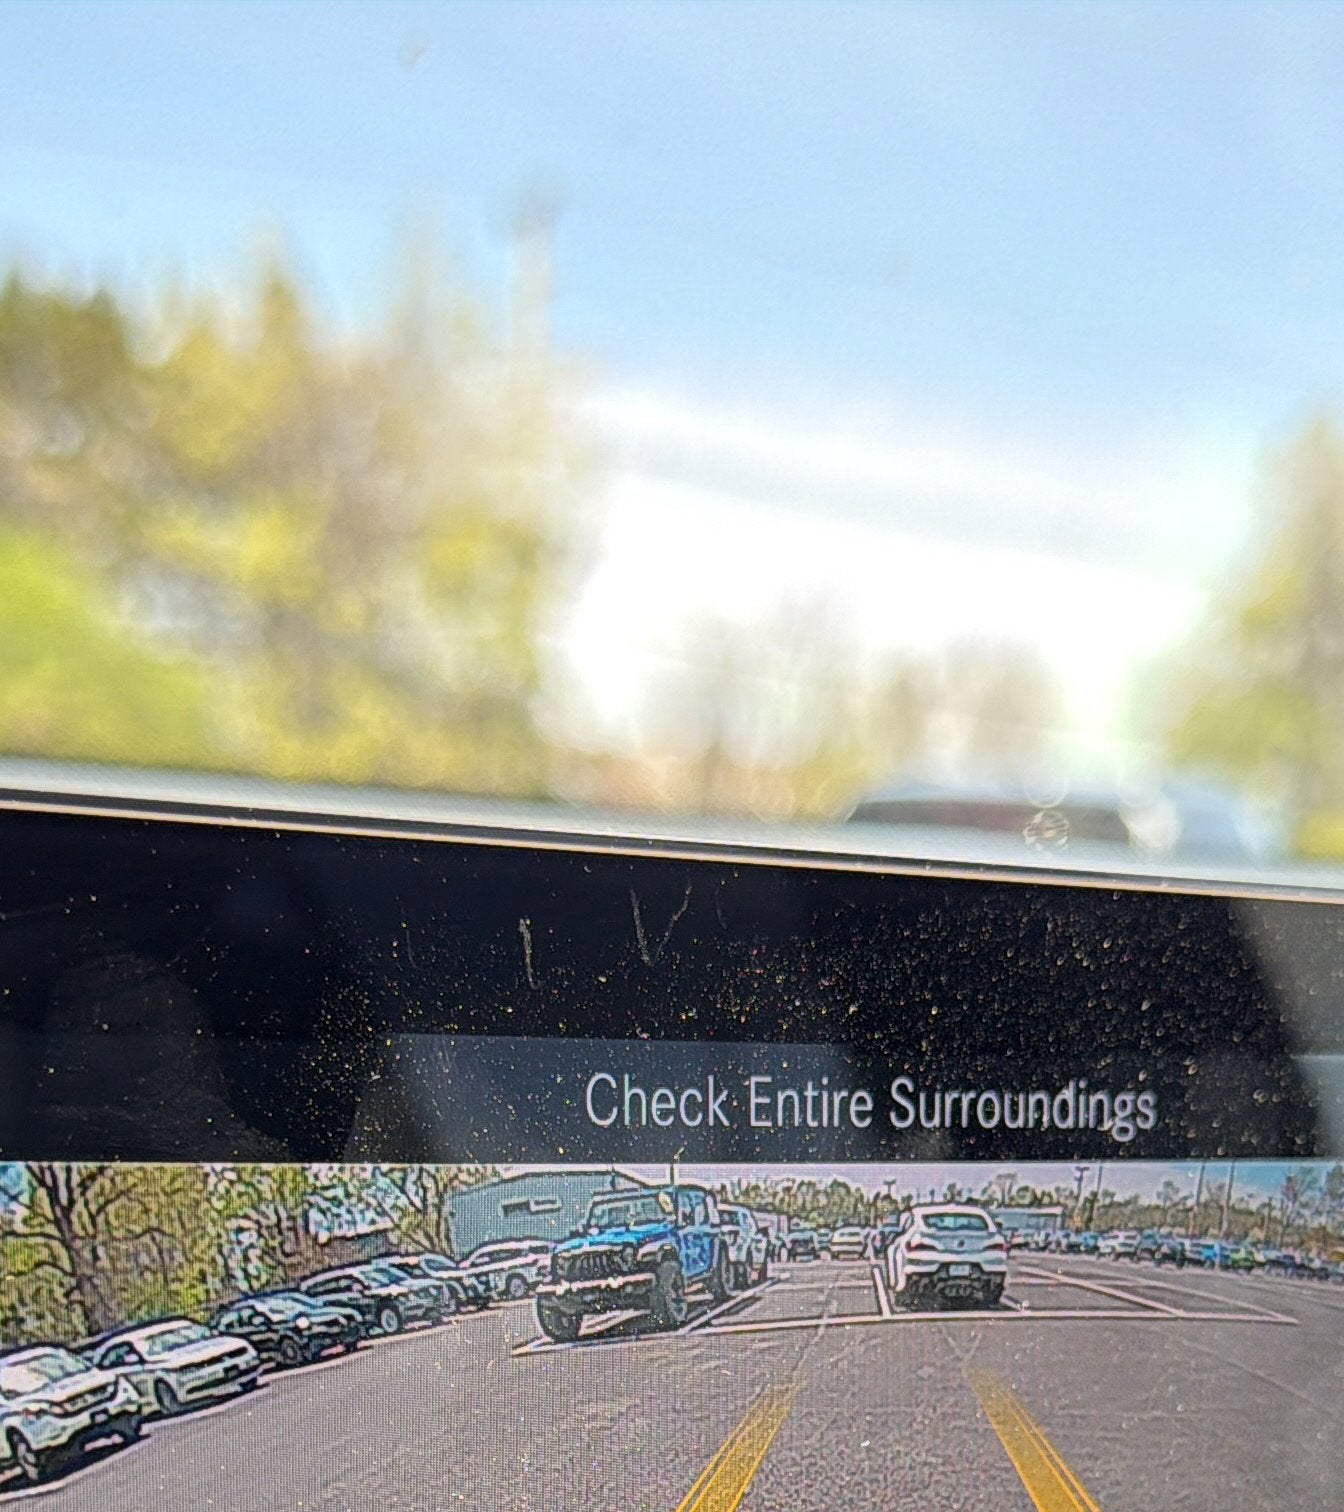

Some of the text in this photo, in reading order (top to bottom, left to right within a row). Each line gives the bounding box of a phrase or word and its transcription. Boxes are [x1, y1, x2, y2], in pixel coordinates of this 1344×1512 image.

[585, 1072, 1157, 1142] Check Entire Surroundings
